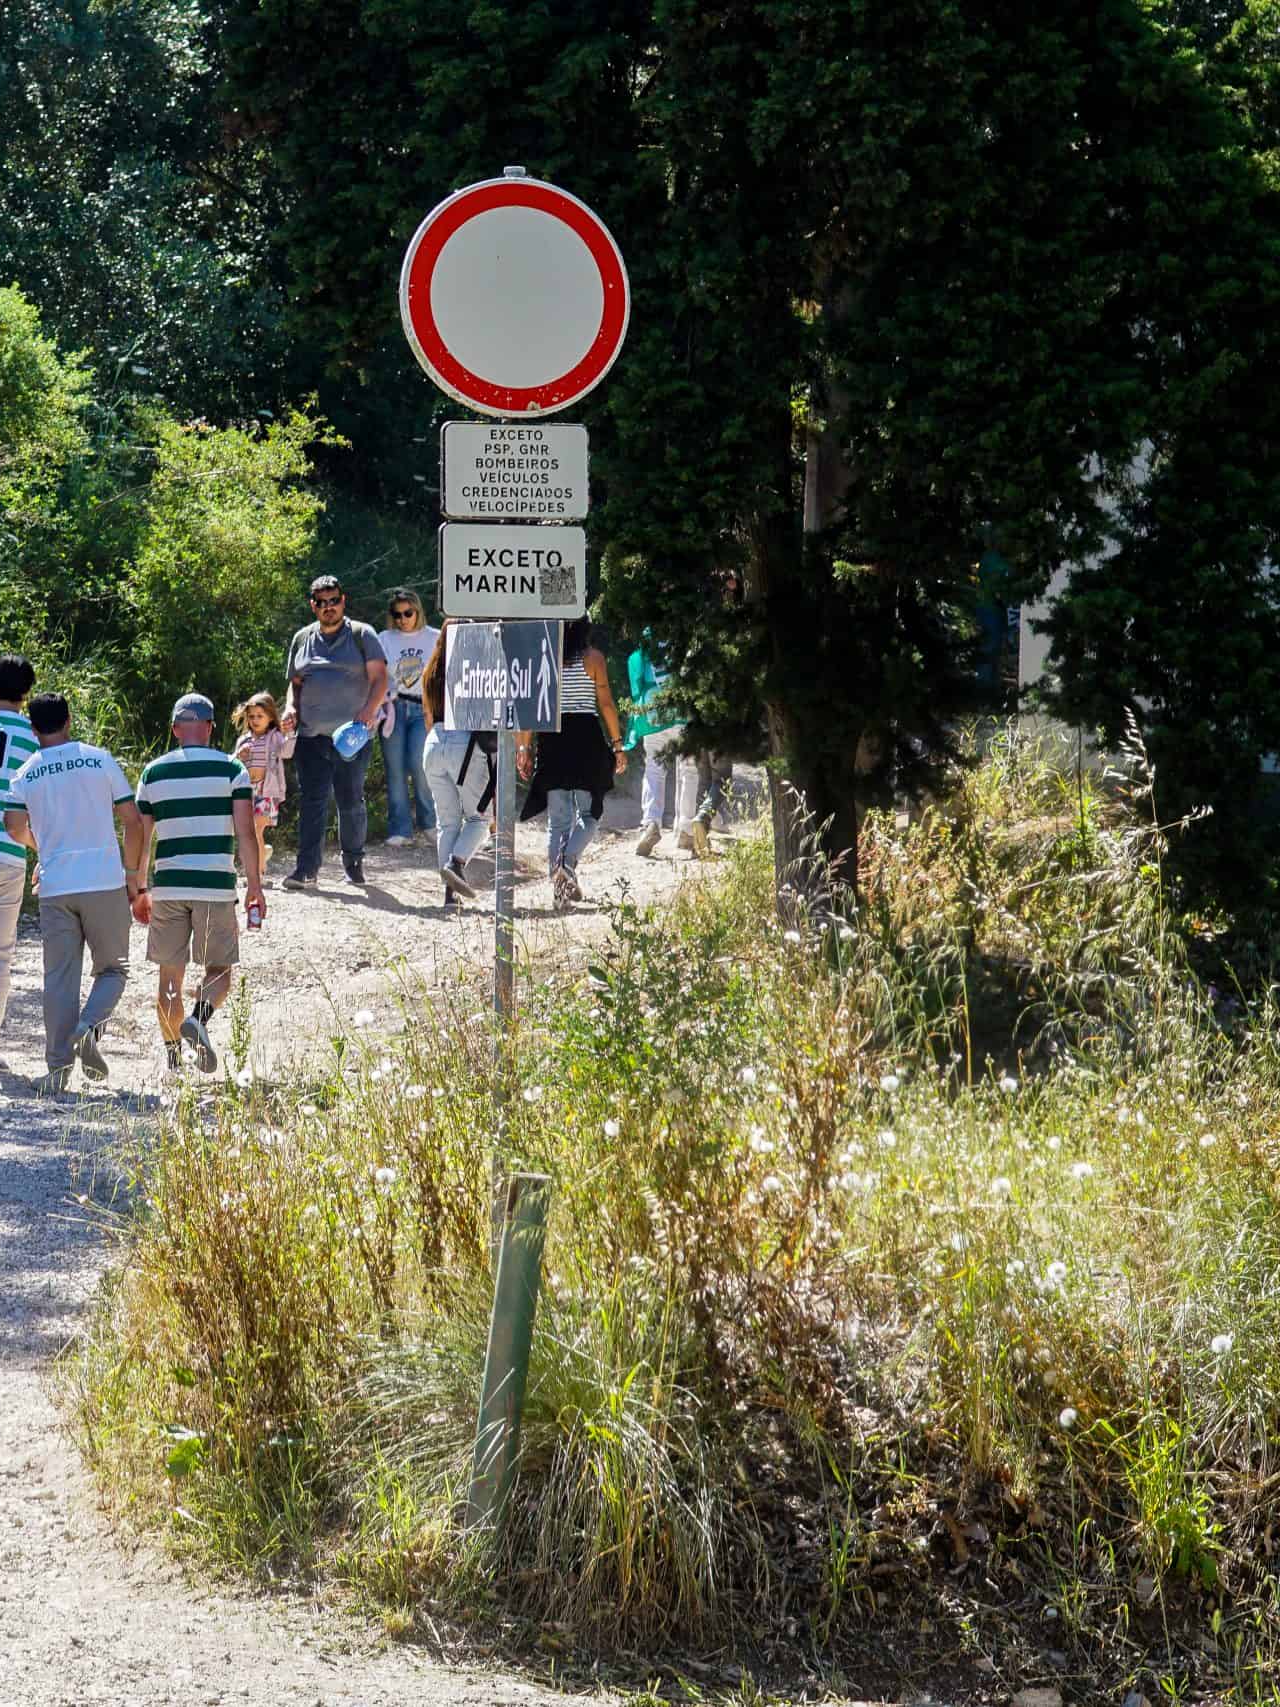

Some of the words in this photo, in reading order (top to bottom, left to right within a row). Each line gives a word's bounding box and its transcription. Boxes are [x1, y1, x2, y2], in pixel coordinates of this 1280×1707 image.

[490, 429, 543, 440] EXCETO
[519, 444, 549, 456] GNR
[475, 458, 559, 470] BOMBEIROS
[479, 470, 549, 484] VEÍCULOS
[461, 486, 573, 499] CREDENCIADOS
[469, 500, 565, 513] VELOCÍPEDES
[468, 548, 562, 568] EXCETO
[455, 574, 536, 594] MARIN
[462, 659, 507, 698] Entrada
[510, 657, 532, 699] Sul
[25, 762, 64, 783] SUPER
[66, 757, 102, 771] BOCK
